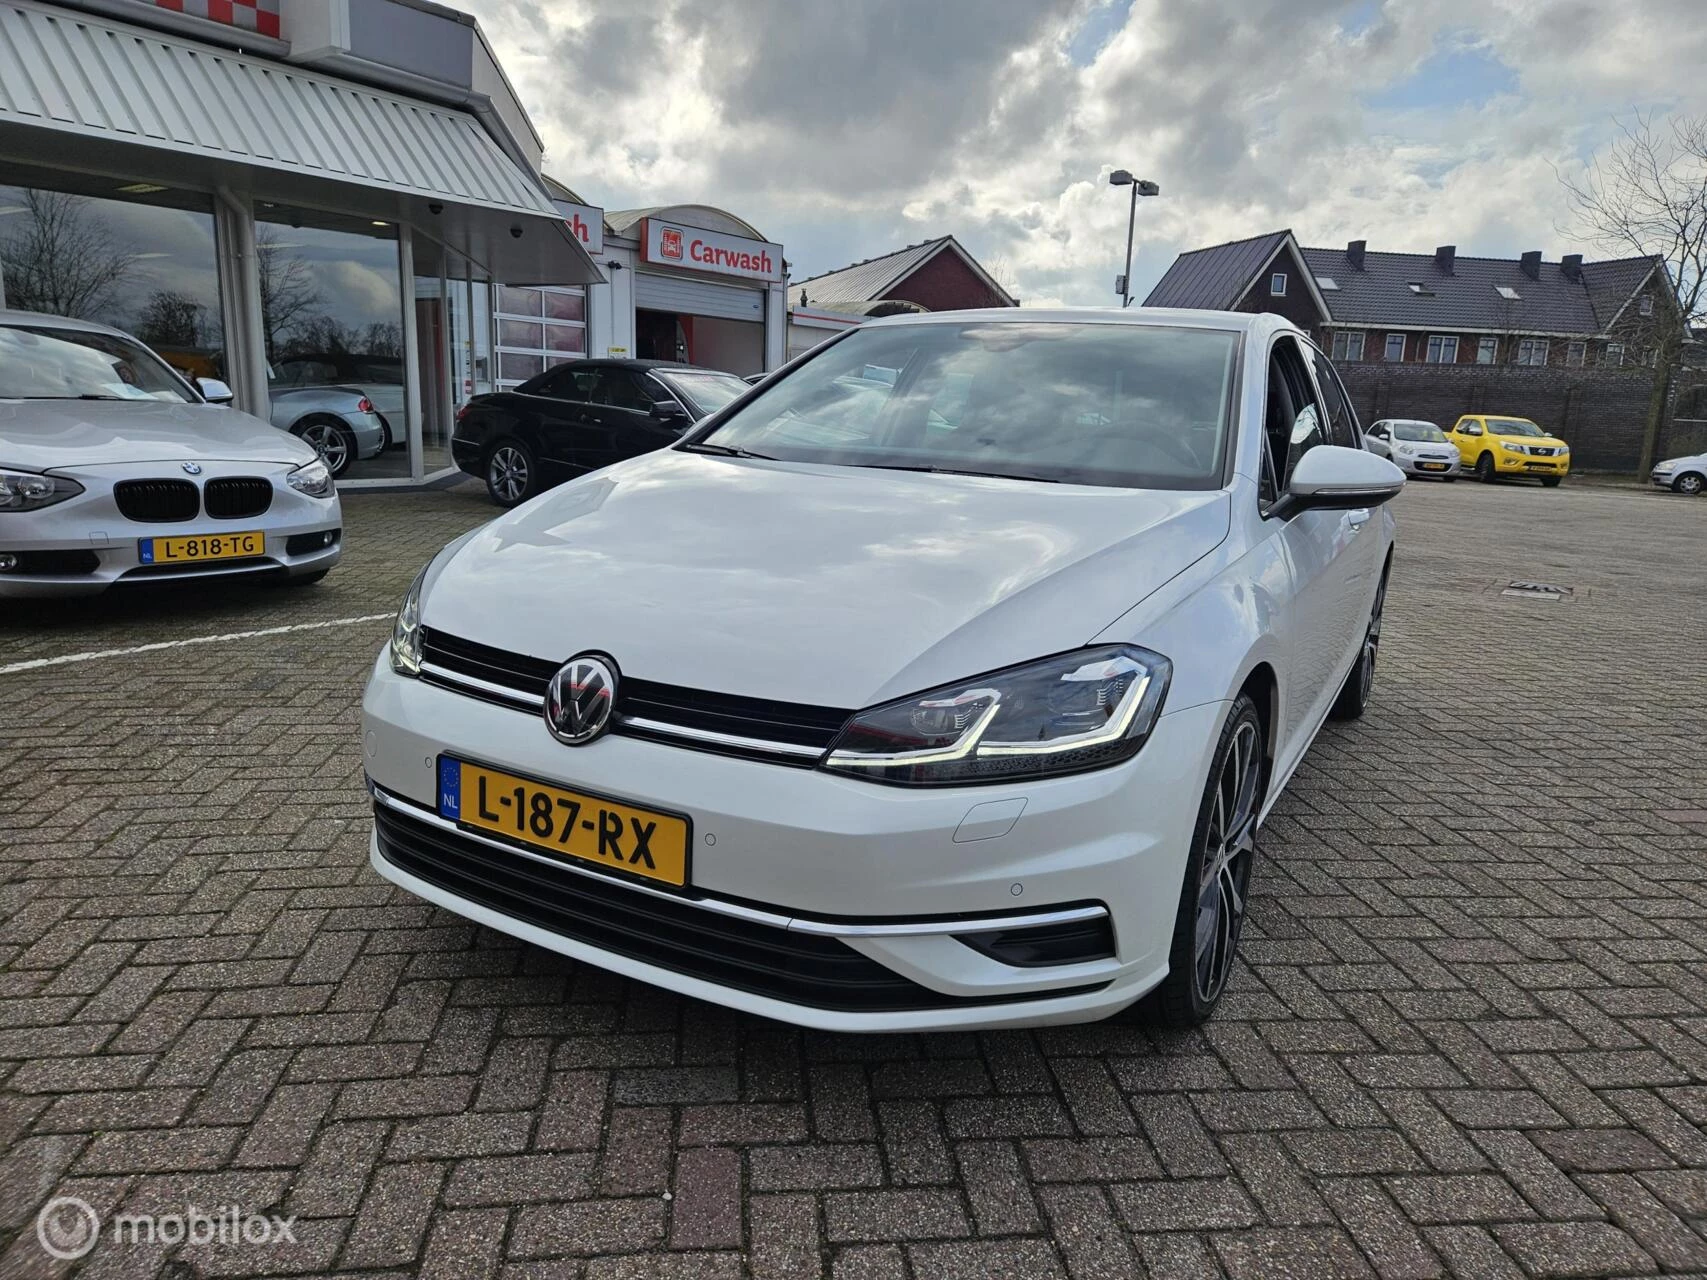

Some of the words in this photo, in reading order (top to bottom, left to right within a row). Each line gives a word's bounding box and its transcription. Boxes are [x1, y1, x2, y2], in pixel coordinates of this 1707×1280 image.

[689, 239, 773, 273] Carwash
[165, 536, 254, 558] L-818-TG
[443, 793, 458, 809] NL
[478, 775, 657, 870] L-187-RX
